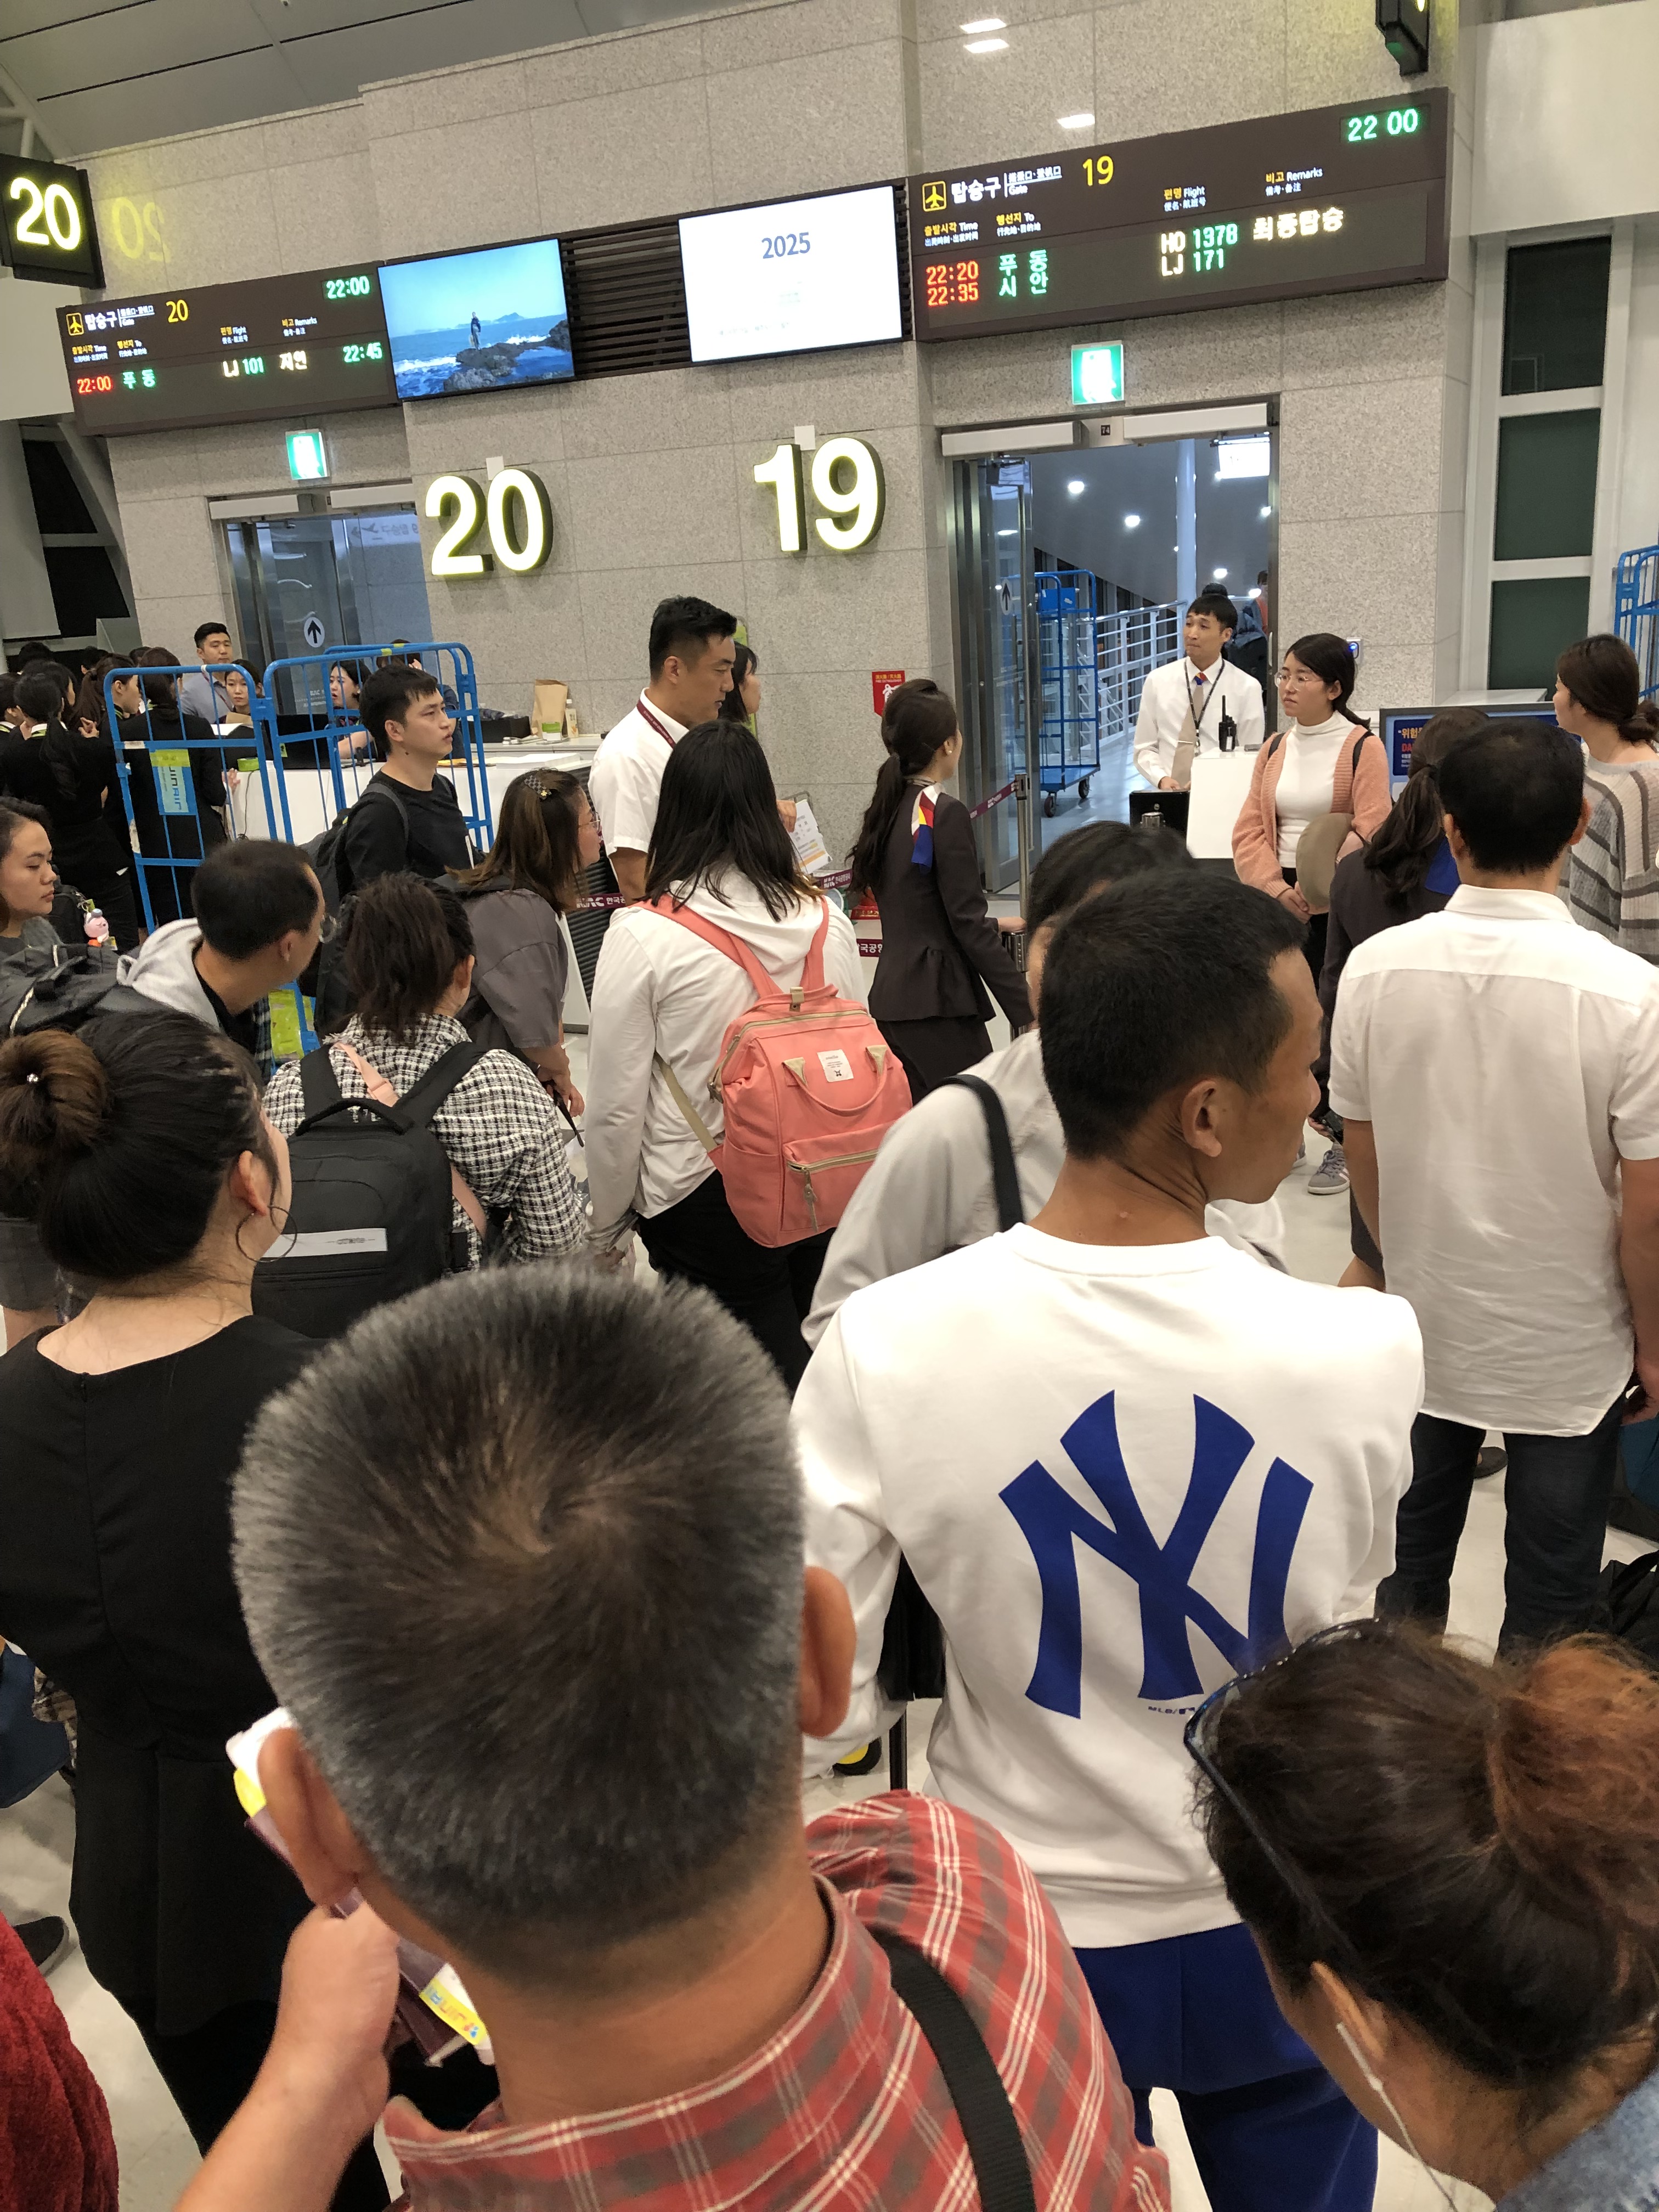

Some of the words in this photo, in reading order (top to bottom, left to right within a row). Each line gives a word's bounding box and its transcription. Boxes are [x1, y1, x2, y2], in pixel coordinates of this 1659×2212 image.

[1082, 155, 1114, 187] 19
[1266, 171, 1285, 183] 비고
[1286, 167, 1323, 181] Remarks
[951, 176, 1001, 204] 탑승구
[1008, 184, 1028, 195] Gate
[1183, 185, 1205, 199] Flight
[10, 177, 81, 250] 20
[996, 212, 1022, 226] 행선지
[1024, 212, 1035, 222] To
[958, 221, 979, 232] Time
[761, 232, 811, 259] 2025
[1160, 230, 1186, 254] HO
[1192, 223, 1239, 250] 1378
[926, 261, 979, 286] 22:20
[1161, 253, 1184, 277] LJ
[1193, 247, 1225, 272] 171
[326, 276, 370, 299] 22:00
[927, 281, 979, 307] 22:35
[84, 311, 117, 331] 탑승구
[166, 300, 189, 323] 20
[295, 316, 318, 326] Remarks
[343, 342, 383, 363] 22:45
[242, 357, 264, 375] 101
[77, 375, 112, 394] 22:00
[753, 437, 881, 552] 19
[425, 469, 550, 576] 20
[998, 1389, 1314, 1719] NY
